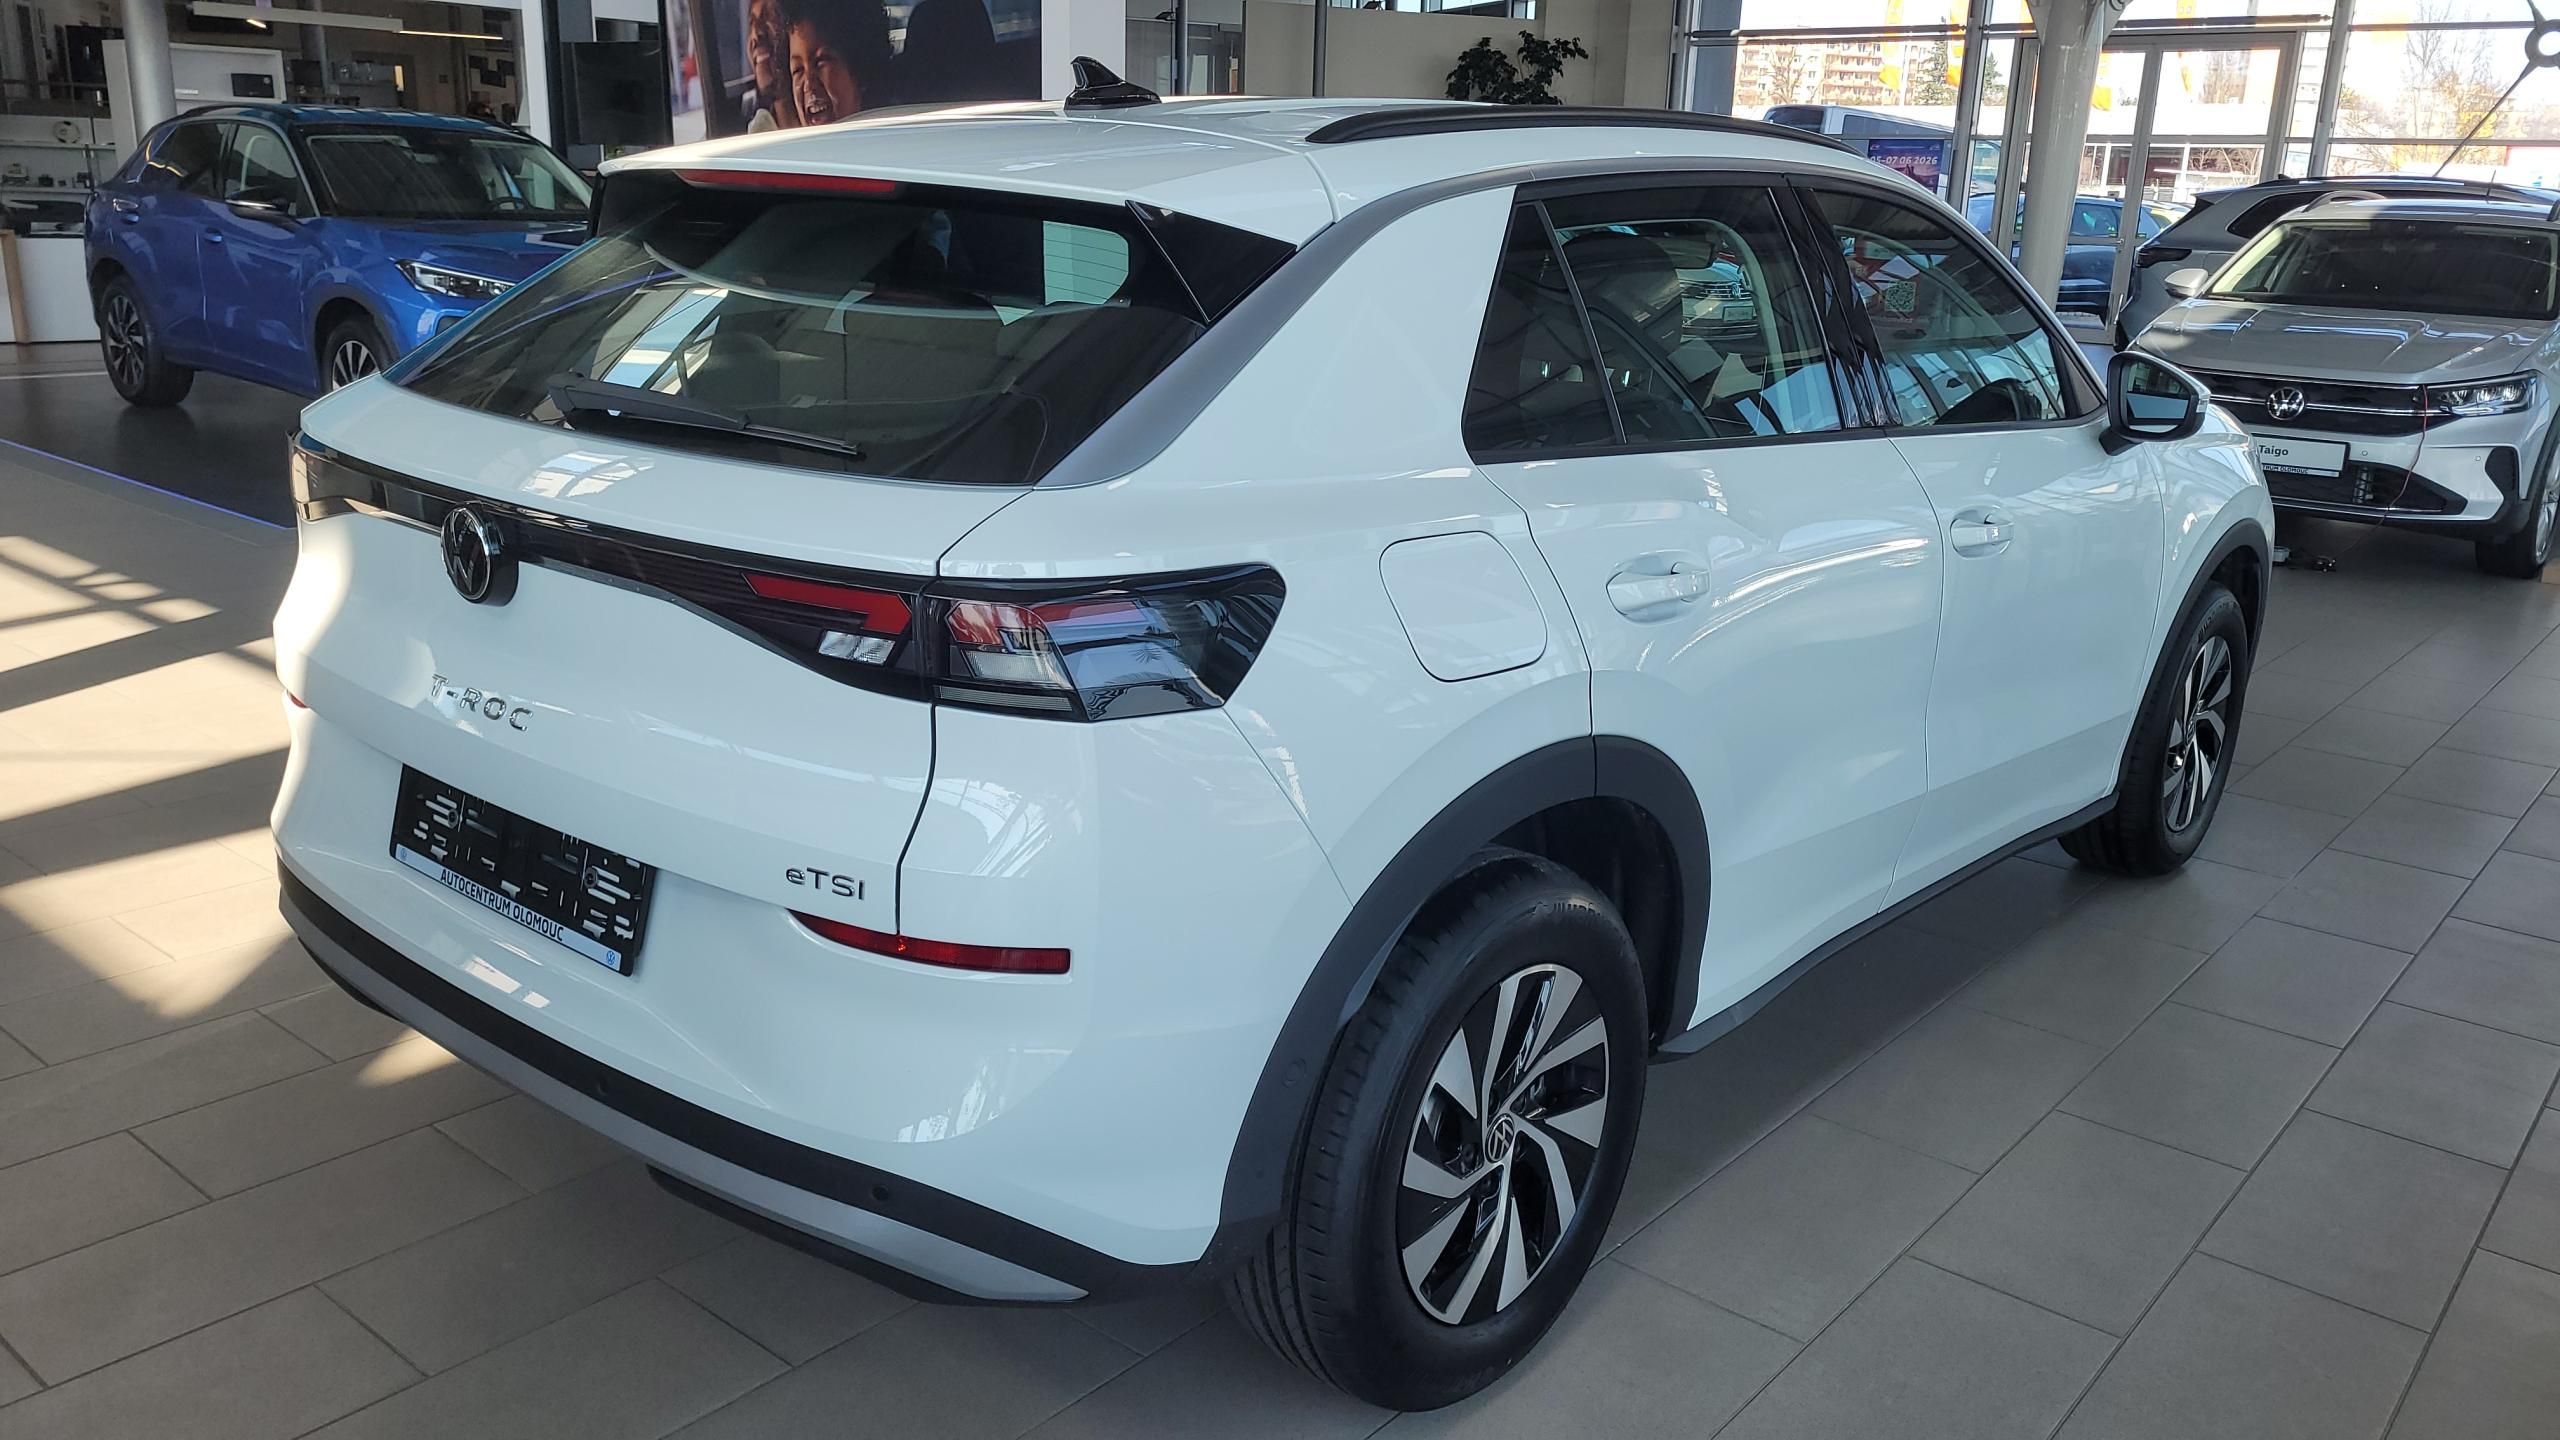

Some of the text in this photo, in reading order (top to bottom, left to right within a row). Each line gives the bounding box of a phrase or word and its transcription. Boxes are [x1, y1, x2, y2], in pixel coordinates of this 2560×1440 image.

[1914, 156, 1938, 165] 2026
[2259, 445, 2289, 457] Taigo
[431, 674, 533, 732] T-ROC
[785, 866, 865, 900] eTSI
[440, 868, 564, 942] AUTOCENTRUM OLOMOUC
